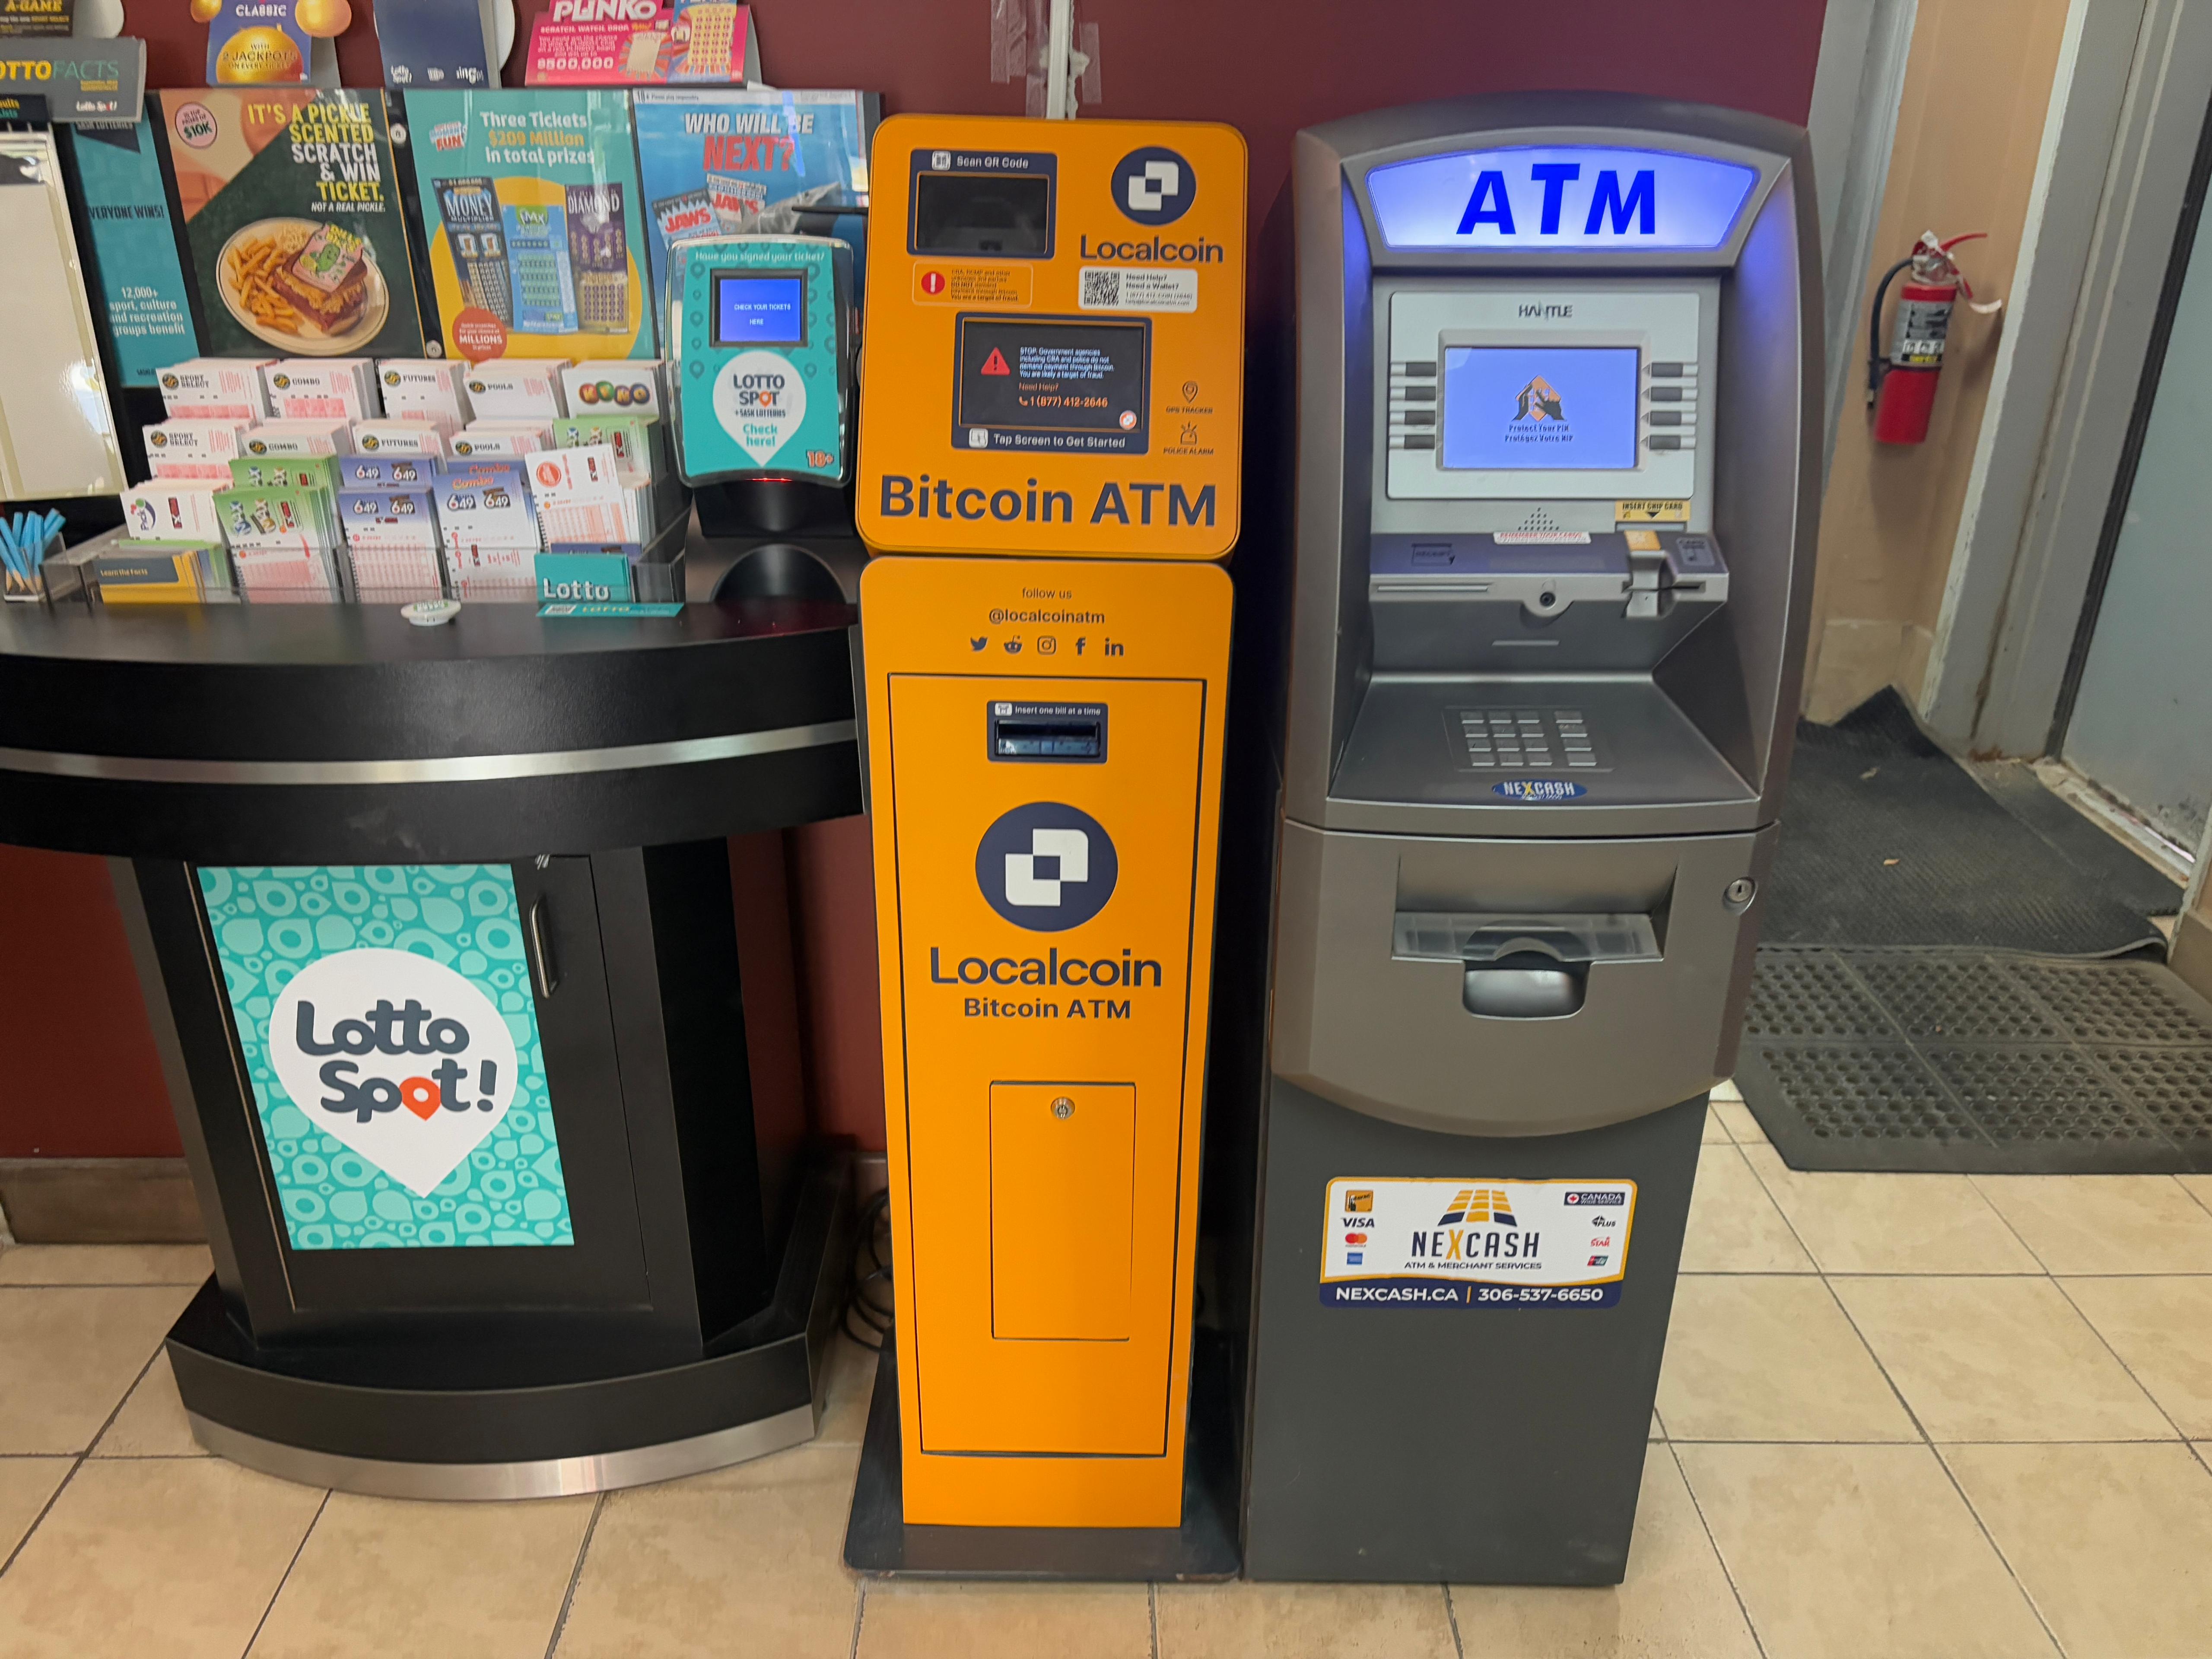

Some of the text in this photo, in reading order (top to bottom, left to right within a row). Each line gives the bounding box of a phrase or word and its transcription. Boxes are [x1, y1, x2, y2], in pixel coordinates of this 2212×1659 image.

[236, 4, 286, 17] CLASSIC
[248, 103, 372, 125] IT'S A PICKLE
[480, 111, 526, 128] Three
[529, 111, 587, 128] Tickets
[685, 112, 730, 135] WHO
[735, 112, 782, 135] WILL
[289, 123, 374, 144] SCENTED
[530, 130, 584, 147] Million
[291, 143, 377, 163] SCRATCH
[503, 147, 544, 164] total
[547, 147, 595, 167] prizes
[702, 135, 795, 172] NEXT?
[957, 156, 1029, 169] Scan QR Code
[320, 162, 381, 182] & WIN
[316, 181, 385, 202] TICKET.
[1456, 163, 1656, 235] ATM
[89, 205, 133, 220] VERYONE
[311, 201, 327, 213] NOT
[328, 201, 334, 213] A
[336, 201, 355, 213] REAL
[444, 192, 493, 218] MONEY
[664, 207, 712, 233] JAWS
[1080, 234, 1224, 264] Localcoin
[696, 252, 719, 261] Have
[721, 253, 737, 263] you
[740, 251, 770, 263] signed
[772, 253, 793, 263] your
[1126, 273, 1167, 283] Need Help?
[1152, 283, 1179, 291] Wallet?
[459, 334, 502, 345] MILLIONS
[292, 377, 320, 386] COMBO
[403, 374, 436, 383] FUTURES
[733, 373, 785, 390] LOTTO
[1039, 383, 1059, 393] Help?
[739, 390, 780, 408] SPOT
[1037, 395, 1062, 408] (877)
[739, 408, 755, 418] SASK
[756, 409, 786, 419] LOTTERIES
[743, 423, 778, 435] Check
[268, 442, 298, 451] COMBO
[381, 439, 418, 448] FUTURES
[474, 442, 501, 451] POOLS
[746, 436, 776, 447] here!
[993, 433, 1125, 448] Tap Screen to Get Started
[880, 473, 1217, 528] Bitcoin ATM
[1622, 502, 1645, 511] INSERT
[543, 577, 610, 601] Lotto
[1022, 587, 1072, 599] follow us
[989, 608, 1106, 625] @localcoinatm
[1015, 705, 1037, 715] Insert
[1055, 706, 1067, 715] bill
[1068, 707, 1076, 715] at
[1084, 706, 1101, 716] time
[1503, 781, 1575, 796] NEXCASH
[930, 946, 1161, 987] Localcoin
[964, 997, 1131, 1020] Bitcoin ATM
[296, 999, 470, 1056] Lotto
[319, 1058, 498, 1123] Spot!
[1341, 1217, 1375, 1228] VISA
[1411, 1229, 1540, 1260] NEXCASH
[1437, 1262, 1494, 1270] MERCHANT
[1336, 1287, 1604, 1303] NEXCASH.CA 306-537-6650
